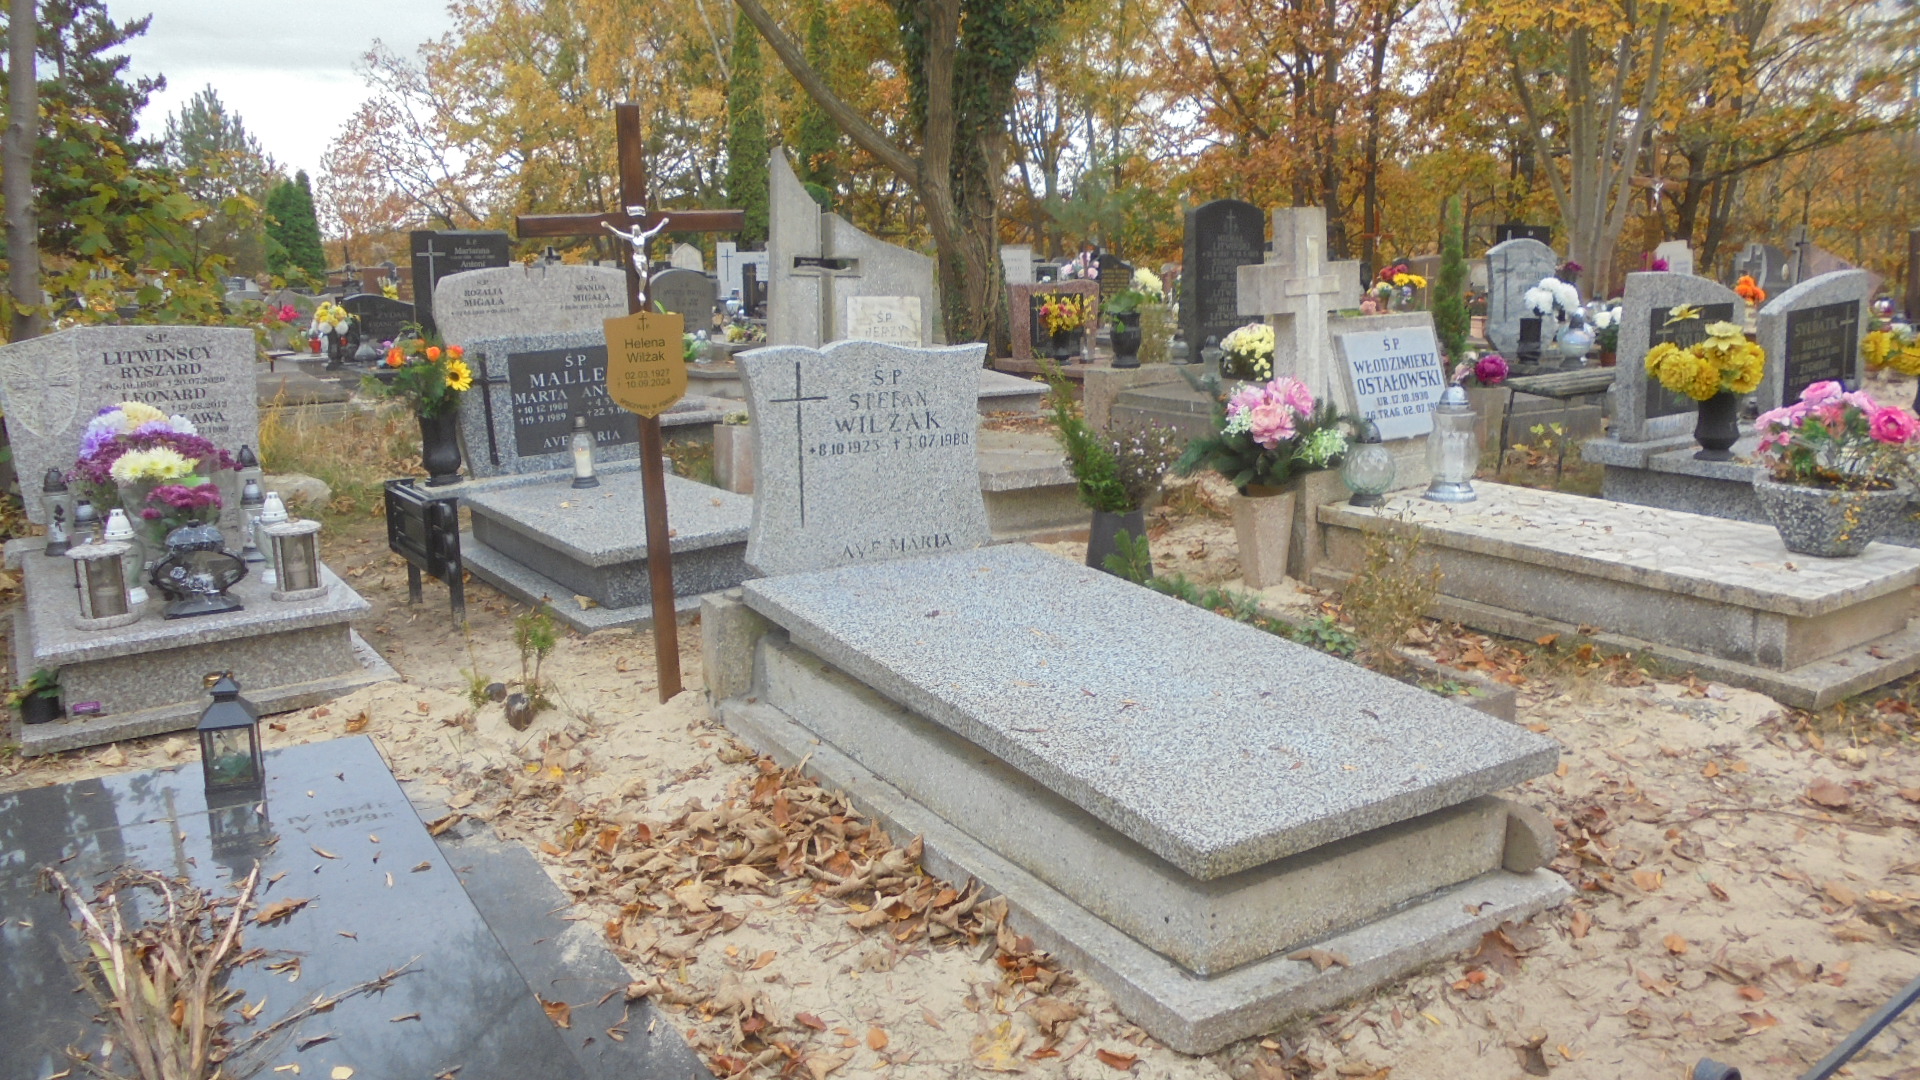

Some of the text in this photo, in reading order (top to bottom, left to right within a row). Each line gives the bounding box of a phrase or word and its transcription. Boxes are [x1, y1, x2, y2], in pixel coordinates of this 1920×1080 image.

[464, 287, 504, 298] ROZALIA
[864, 325, 909, 338] JERZY
[624, 337, 666, 350] Helena
[626, 351, 666, 364] Wilżak
[1353, 352, 1436, 375] WŁODZIMIERZ
[120, 361, 203, 379] RYSZARD
[528, 366, 607, 389] MALLE
[1356, 369, 1442, 396] OSTAŁOWSKI
[121, 387, 207, 404] LEONARD
[514, 388, 569, 406] MARTA
[848, 389, 928, 412] STEFAN
[543, 435, 569, 450] AVE
[842, 532, 953, 559] AVE MARIA
